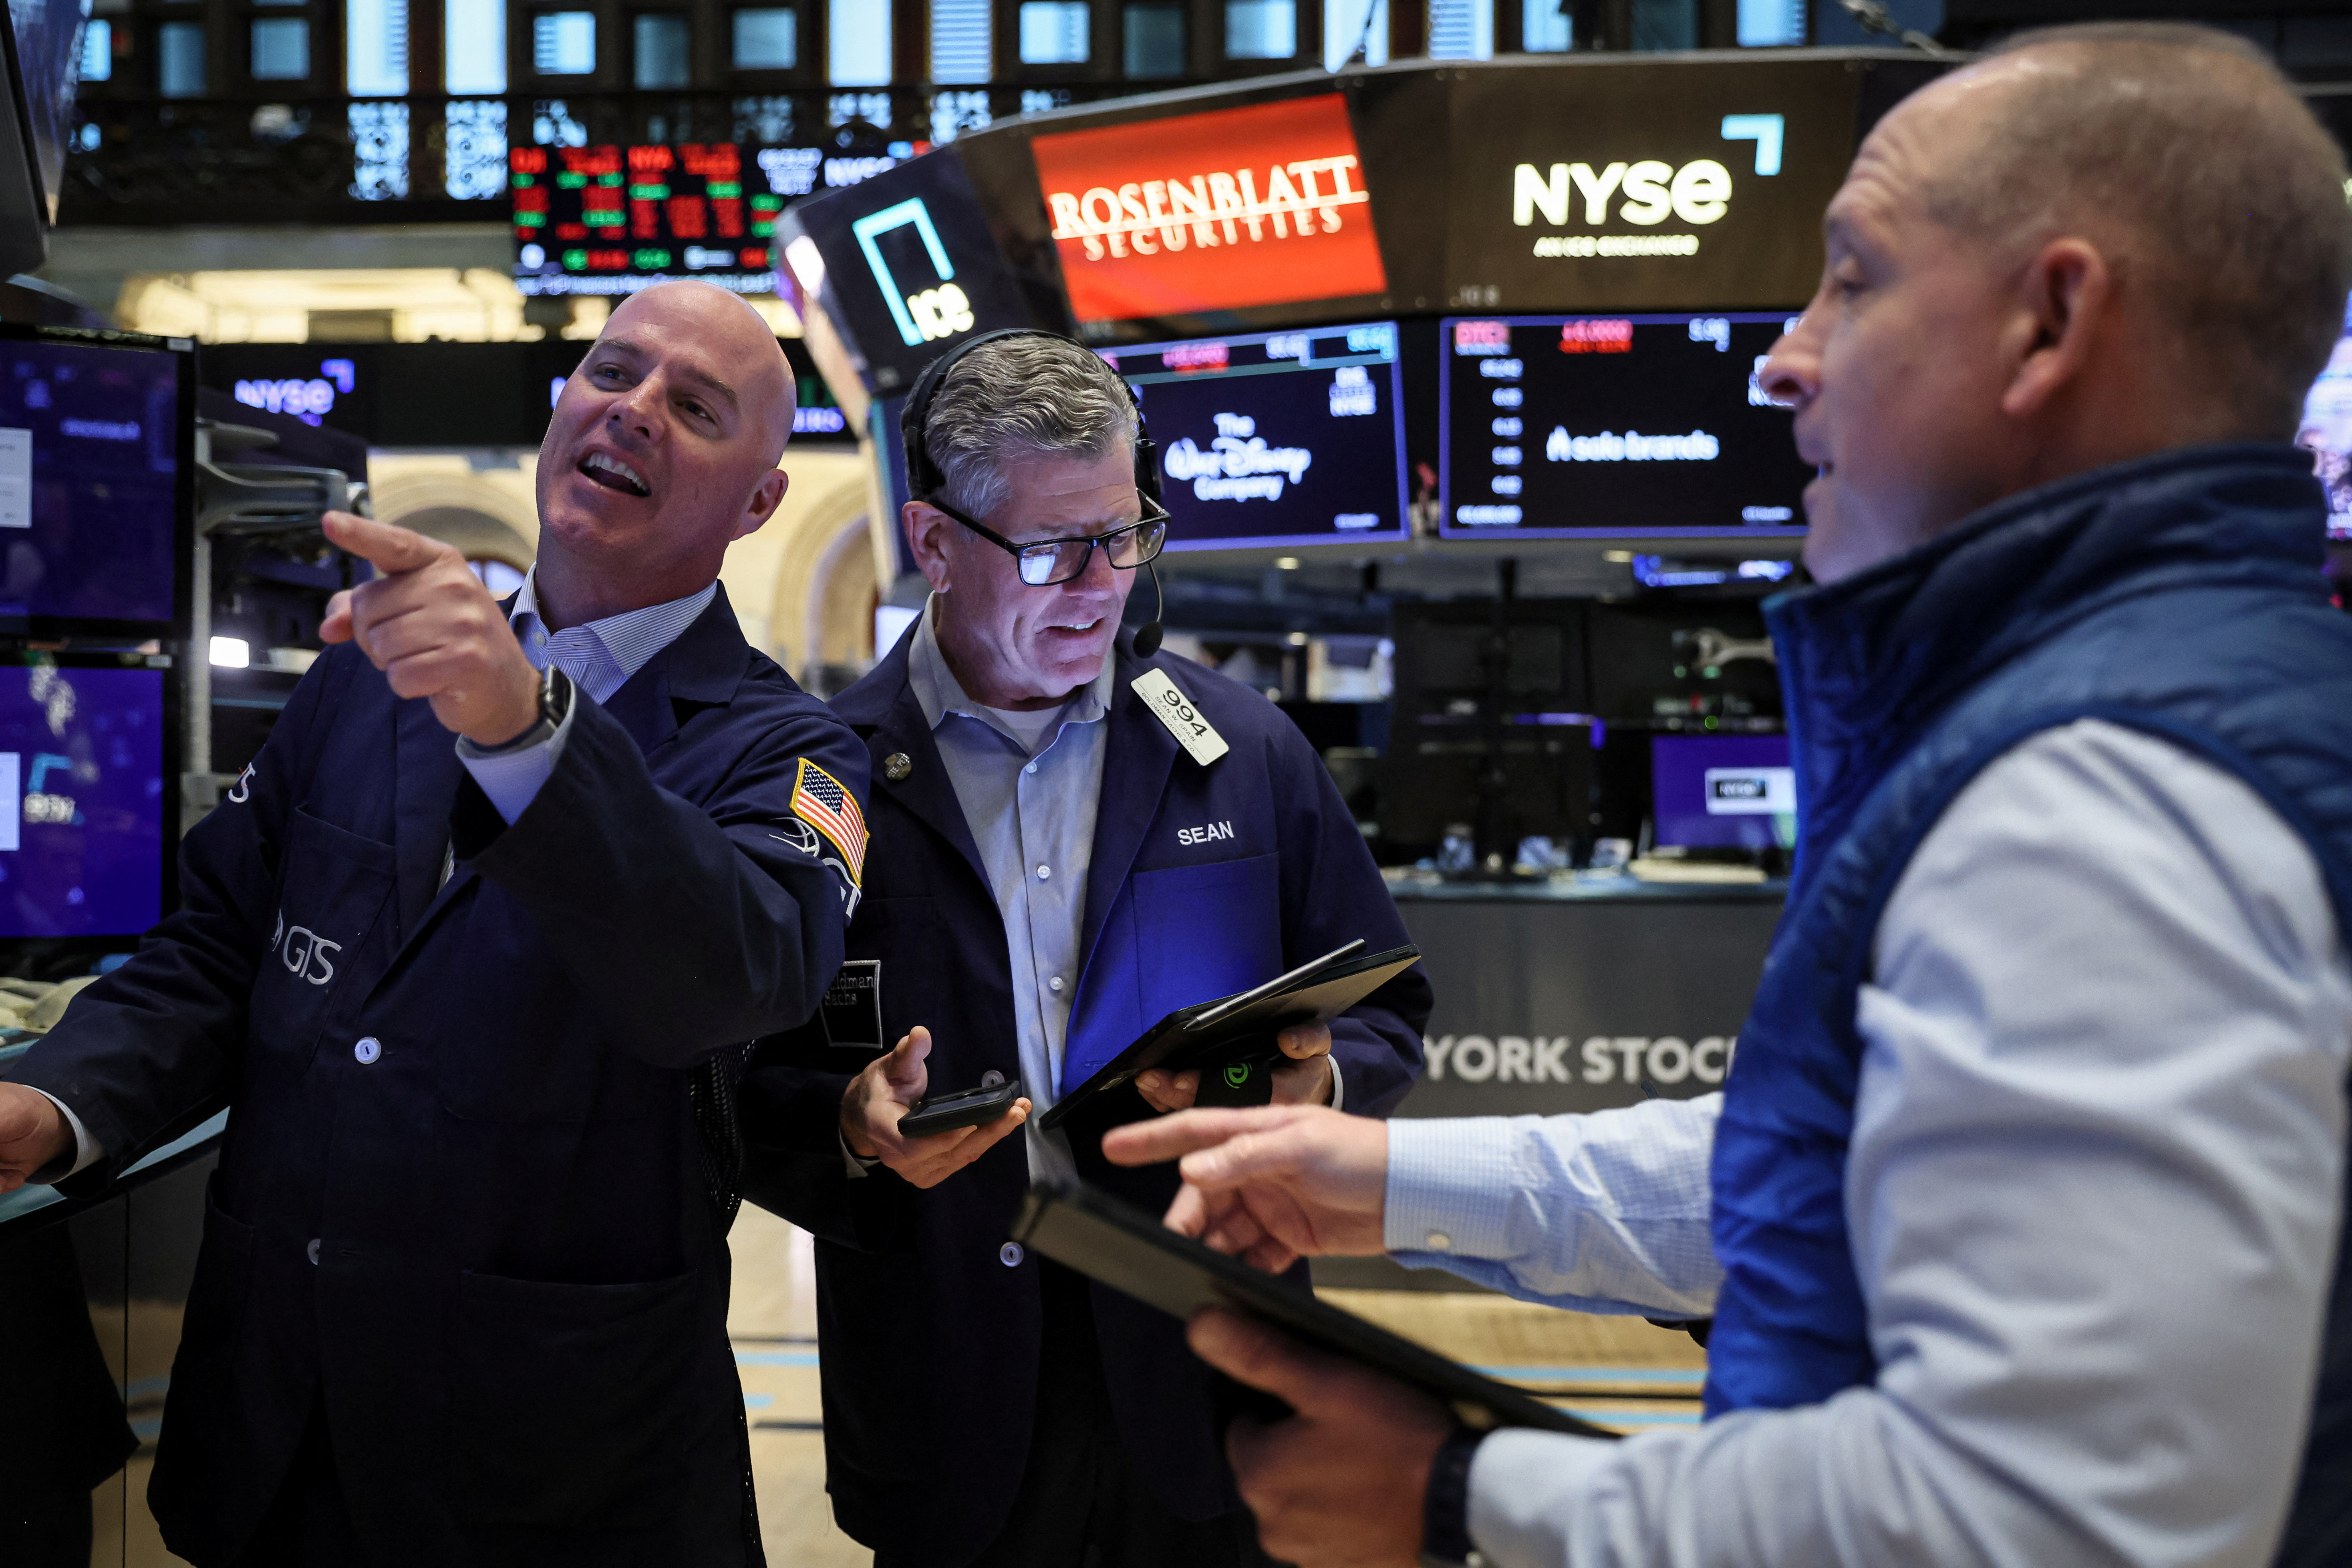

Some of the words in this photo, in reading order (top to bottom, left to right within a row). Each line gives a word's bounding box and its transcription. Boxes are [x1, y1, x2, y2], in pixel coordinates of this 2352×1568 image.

[1048, 154, 1358, 238] ROSENBLATT
[1081, 204, 1343, 261] SECURITIES
[1213, 412, 1256, 438] The
[1625, 430, 1720, 461] brands
[1141, 692, 1166, 719] GOLDMAN
[1165, 719, 1182, 738] SACHS
[1155, 696, 1171, 714] SEAN
[1172, 715, 1178, 723] W.
[1179, 723, 1196, 742] SPAIN
[1163, 690, 1207, 737] 994
[1177, 820, 1235, 845] SEAN
[283, 926, 342, 985] GTS
[1423, 1034, 1573, 1084] YORK
